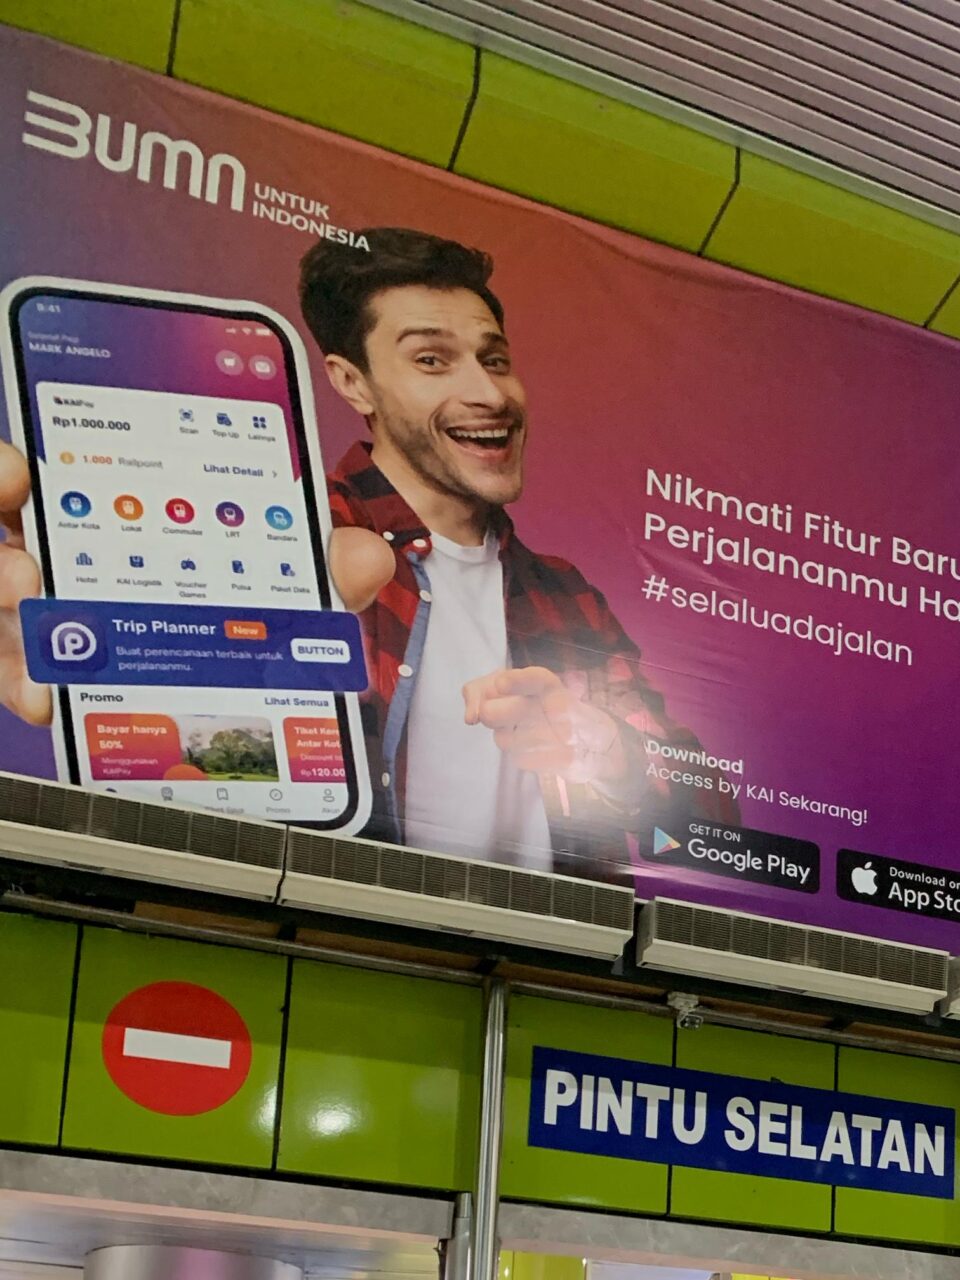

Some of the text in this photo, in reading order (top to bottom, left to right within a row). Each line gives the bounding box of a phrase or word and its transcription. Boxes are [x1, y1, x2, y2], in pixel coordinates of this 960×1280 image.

[22, 90, 246, 212] BUMN
[254, 182, 330, 220] UNTUK
[252, 202, 371, 252] INDONESIA
[29, 342, 112, 358] MARK ANGELO
[52, 416, 131, 431] Rp1.000.000
[203, 463, 264, 477] Lihat Detail
[645, 468, 793, 534] Nikmati
[804, 511, 881, 557] Fitur
[643, 512, 908, 608] Perjalananmu
[112, 619, 217, 636] Trip Planner
[641, 574, 913, 666] #selaluadajalan
[232, 625, 259, 637] New
[116, 646, 142, 657] Buat
[143, 647, 214, 660] perencanaan
[296, 645, 345, 657] BUTTON
[80, 692, 124, 703] Promo
[264, 697, 330, 707] Lihat Semua
[97, 724, 168, 736] Bayar hanya
[296, 740, 321, 748] Antar
[645, 739, 744, 774] Download
[645, 763, 869, 827] Access by KAI Sekarang!
[688, 823, 741, 843] GET IT ON
[687, 837, 811, 885] Google Play
[889, 866, 946, 888] Download
[888, 882, 931, 911] App
[543, 1069, 946, 1177] PINTU SELATAN
